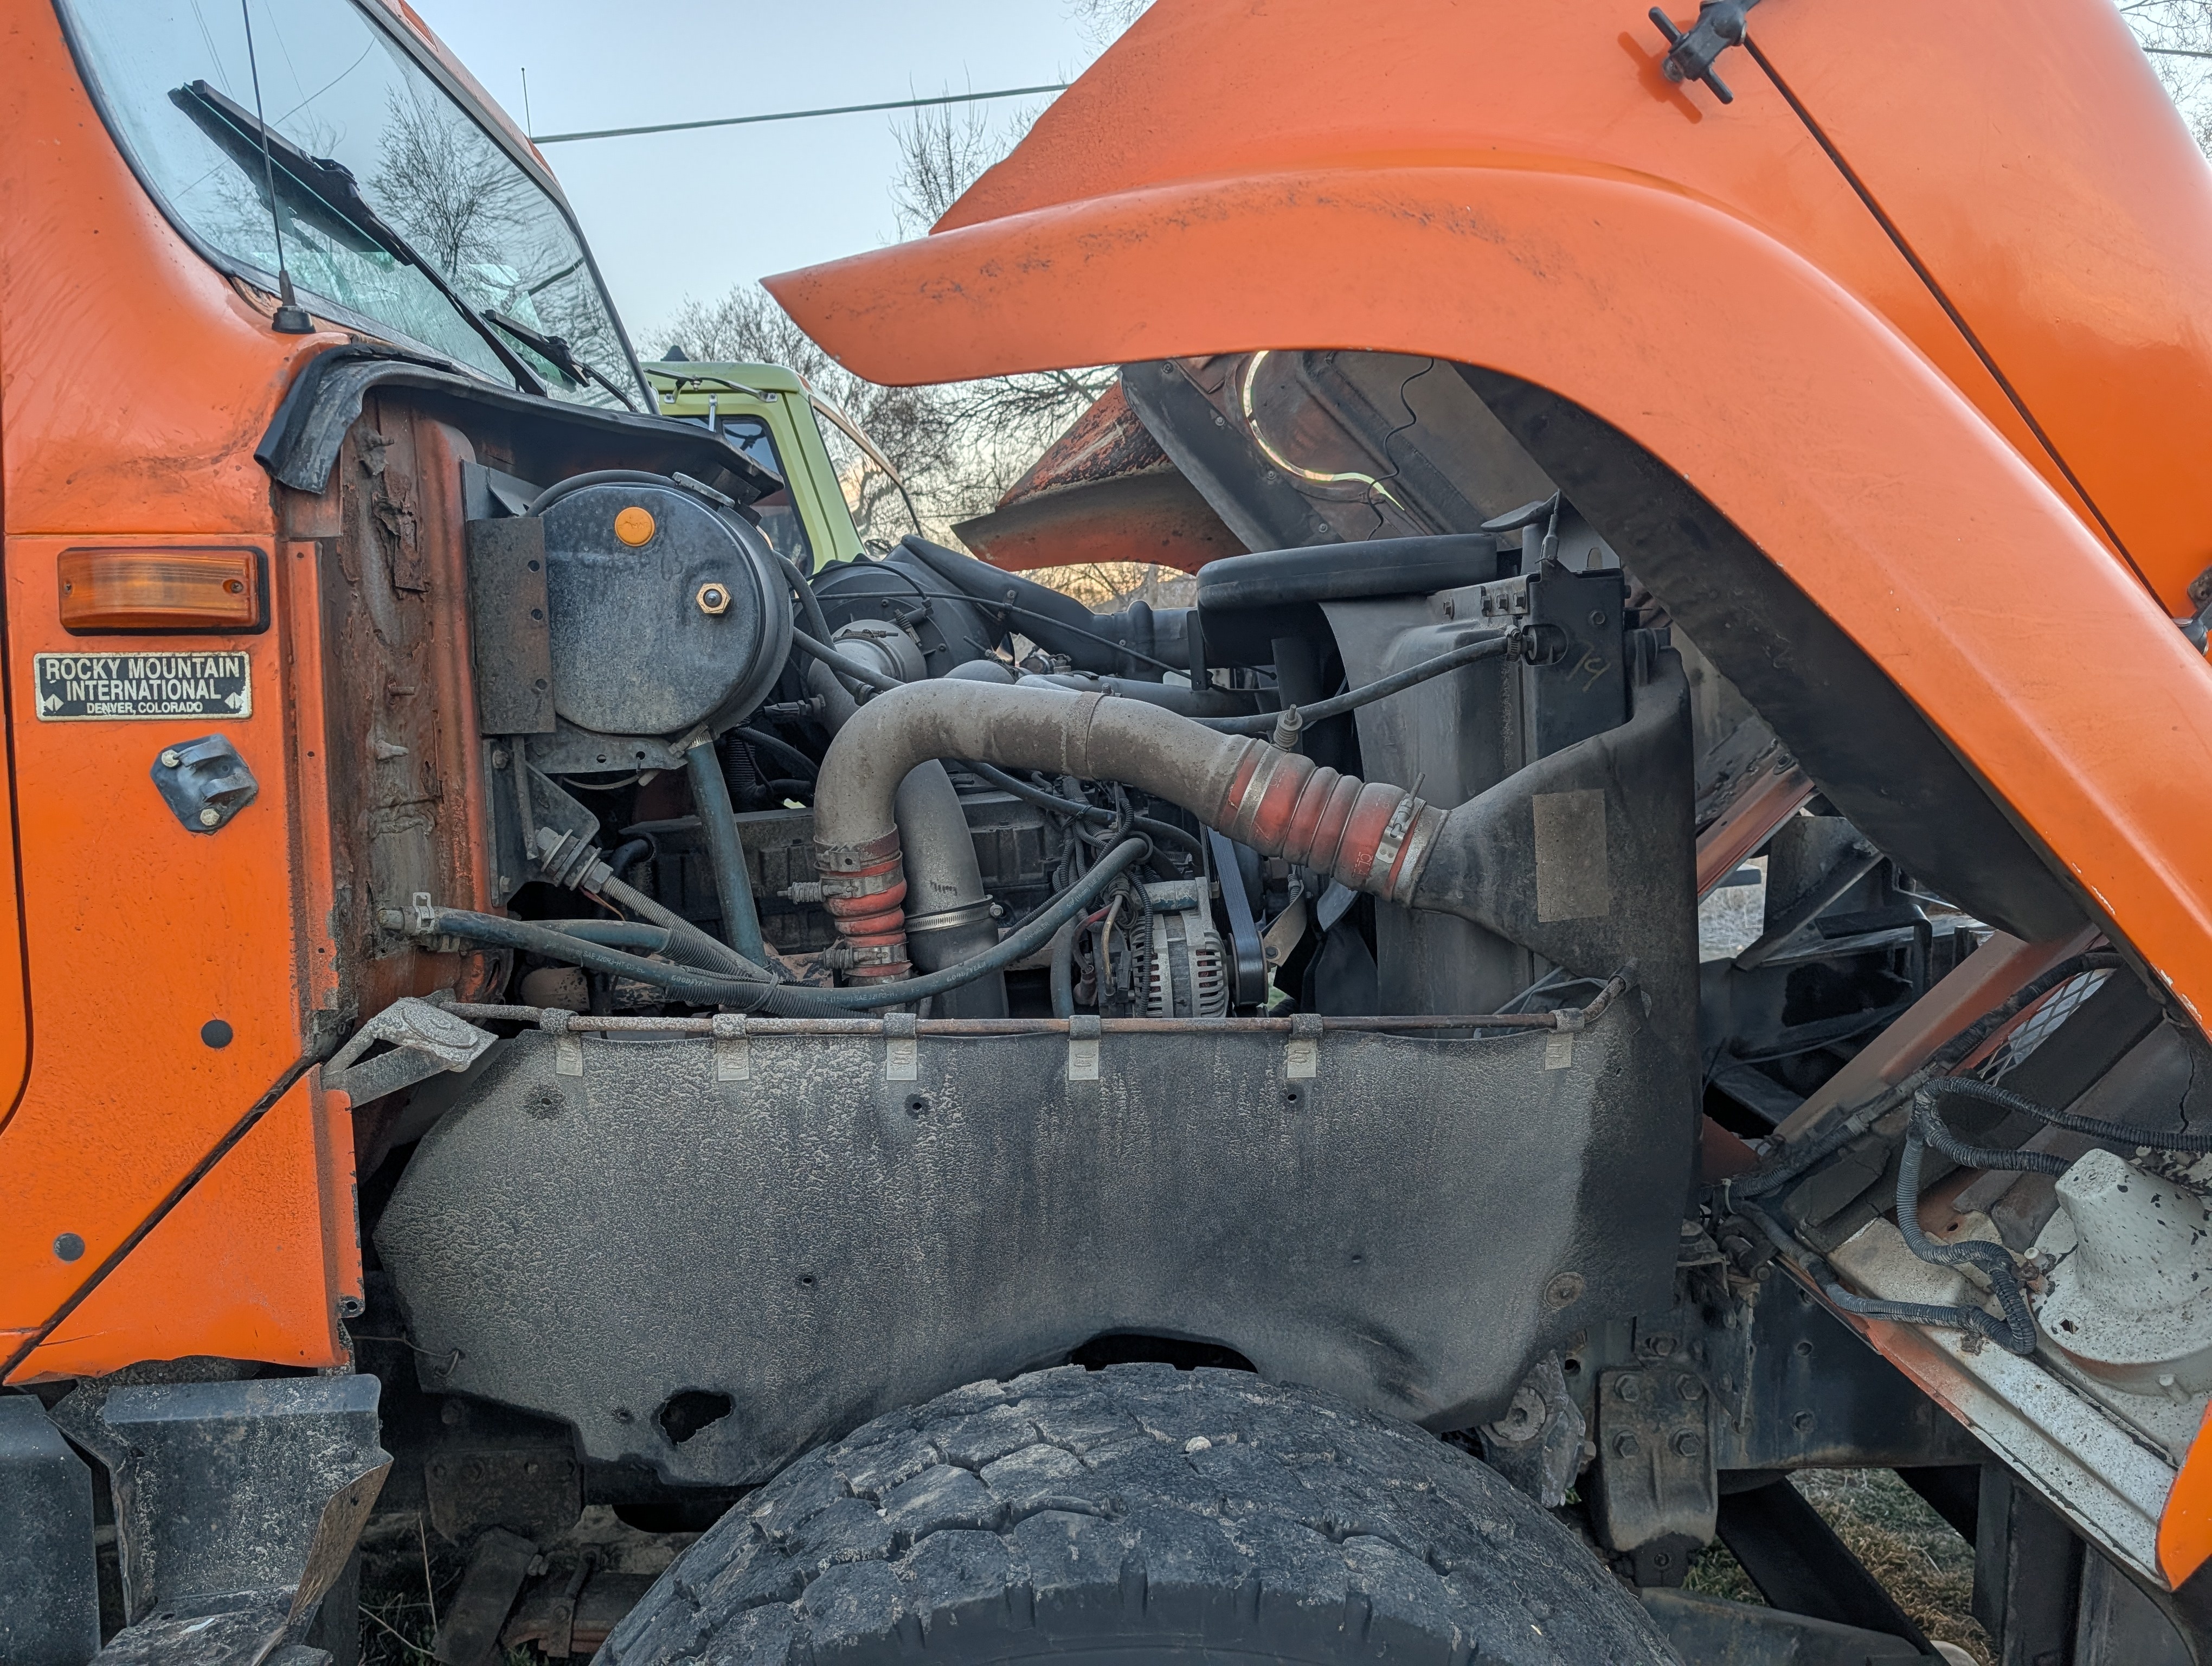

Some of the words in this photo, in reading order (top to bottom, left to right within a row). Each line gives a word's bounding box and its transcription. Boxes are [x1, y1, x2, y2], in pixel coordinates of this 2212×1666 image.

[46, 658, 121, 680] ROCKY
[128, 657, 240, 678] MOUNTAIN
[67, 679, 221, 701] INTERNATIONAL
[87, 702, 136, 715] DENVER,
[138, 702, 203, 713] COLORADO
[583, 951, 596, 959] SAE
